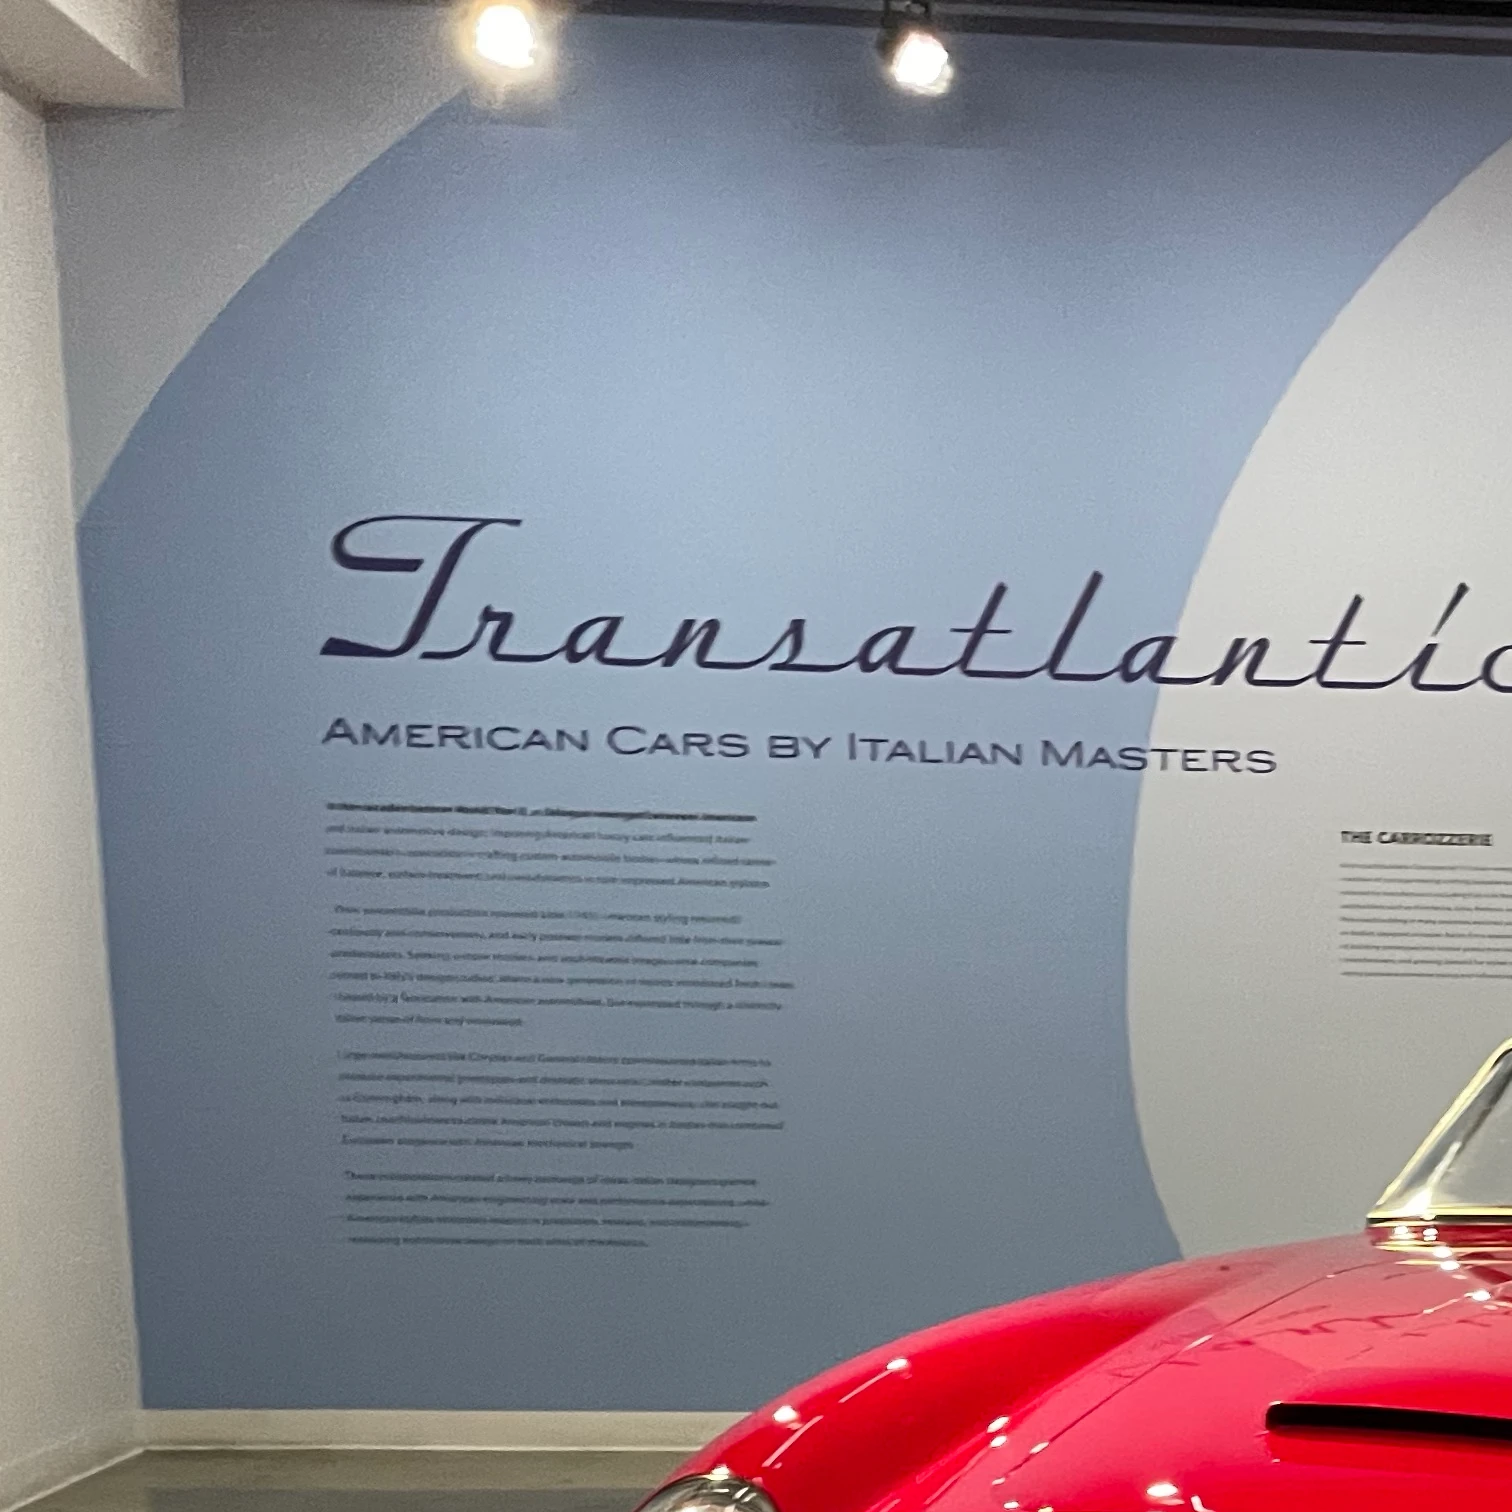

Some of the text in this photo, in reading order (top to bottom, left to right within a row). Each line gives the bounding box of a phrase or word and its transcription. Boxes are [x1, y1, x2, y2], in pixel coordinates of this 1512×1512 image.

[321, 717, 1278, 774] AMERICAN CARS BY ITALIAN MASTERS
